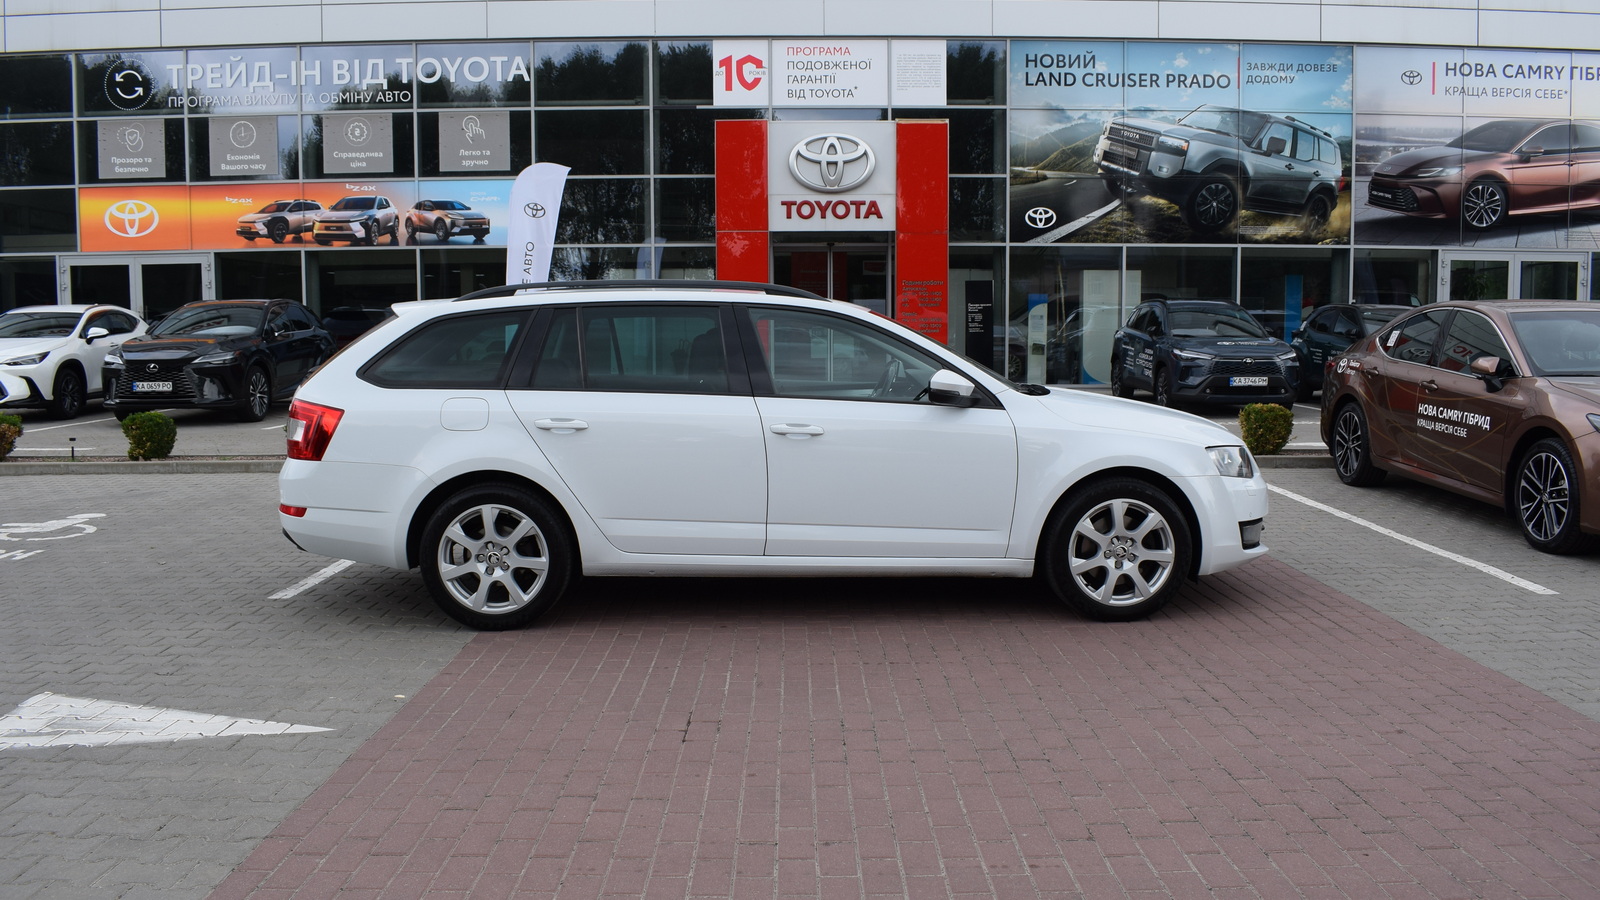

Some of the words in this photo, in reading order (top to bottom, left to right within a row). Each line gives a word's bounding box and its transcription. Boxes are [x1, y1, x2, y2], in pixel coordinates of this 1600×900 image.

[786, 46, 851, 56] ПРОГРАМА
[786, 58, 872, 71] ПОДОВЖЕНОЇ
[1025, 50, 1096, 69] НОВИЙ
[166, 55, 321, 93] ТРЕЙД-ІН
[332, 58, 388, 91] ВІД
[396, 55, 531, 84] TOYOTA
[1246, 62, 1294, 73] ЗАВЖДИ
[1296, 63, 1338, 73] ДОВЕЗЕ
[1445, 62, 1497, 78] НОВА
[1502, 64, 1565, 80] CAMRY
[786, 73, 837, 84] ГАРАНТІЇ
[1025, 72, 1077, 87] LAND
[1082, 73, 1160, 88] CRUISER
[1166, 74, 1231, 89] PRADO
[1246, 75, 1296, 85] ДОДОМУ
[168, 96, 242, 108] ПРОГРАМА
[245, 93, 298, 105] ВИКУПУ
[301, 93, 316, 104] ТА
[319, 91, 373, 104] ОБМІНУ
[376, 90, 412, 103] АВТО
[787, 89, 806, 99] ВІД
[1445, 86, 1488, 99] КРАЩА
[1491, 88, 1531, 98] ВЕРСІЯ
[1121, 130, 1140, 139] TOYOTA
[111, 156, 143, 164] Прозоро
[350, 160, 367, 168] ціна
[114, 165, 149, 173] безпечно
[249, 163, 267, 171] часу
[780, 200, 883, 219] TOYOTA
[523, 241, 535, 275] АВТО
[1417, 403, 1437, 417] НОВА
[1438, 407, 1463, 423] CAMRY
[1463, 411, 1491, 431] ГІБРИД
[1416, 418, 1435, 431] КРАЩА
[1435, 421, 1453, 435] ВЕРСІЯ
[1453, 426, 1468, 438] СЕБЕ
